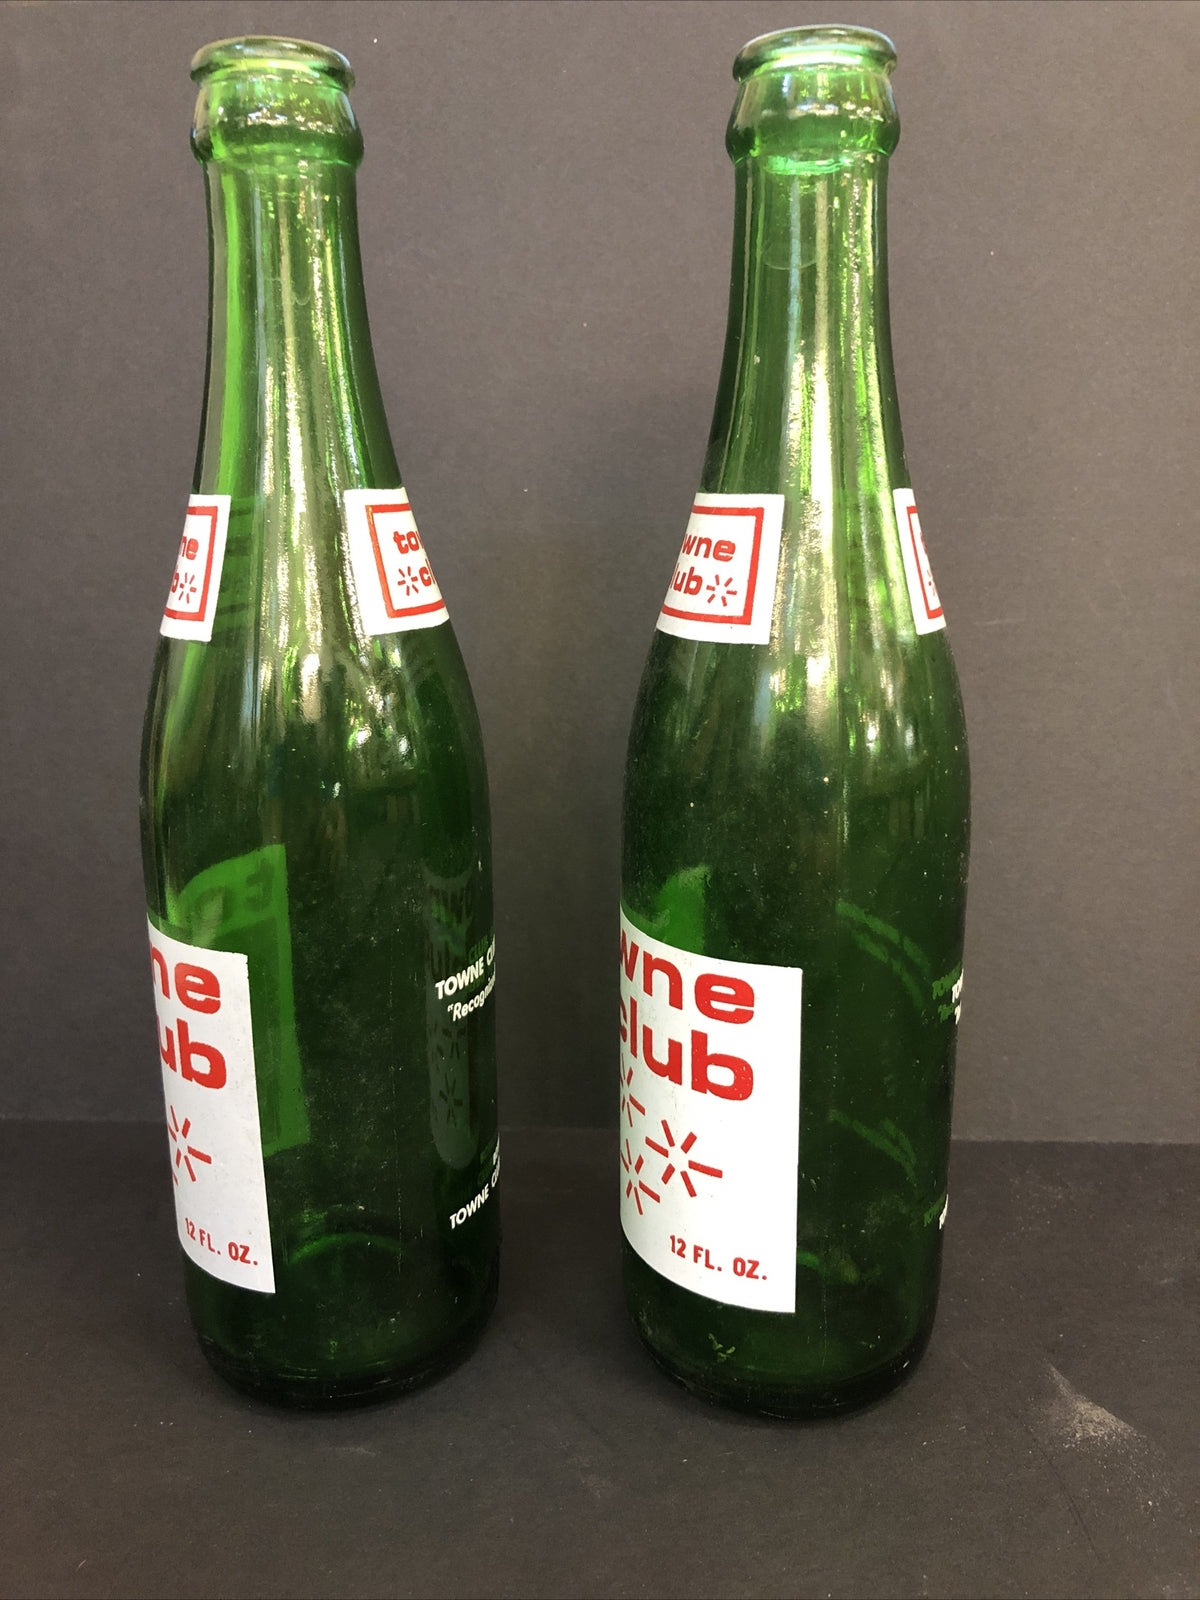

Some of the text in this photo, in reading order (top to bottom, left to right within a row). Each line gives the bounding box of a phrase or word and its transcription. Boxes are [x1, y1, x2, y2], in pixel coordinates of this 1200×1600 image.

[434, 956, 485, 1000] TOWNE
[449, 1183, 490, 1230] TOWNE
[184, 1217, 259, 1266] 12 FL. OZ.
[670, 1234, 768, 1281] 12 FL. OZ.
